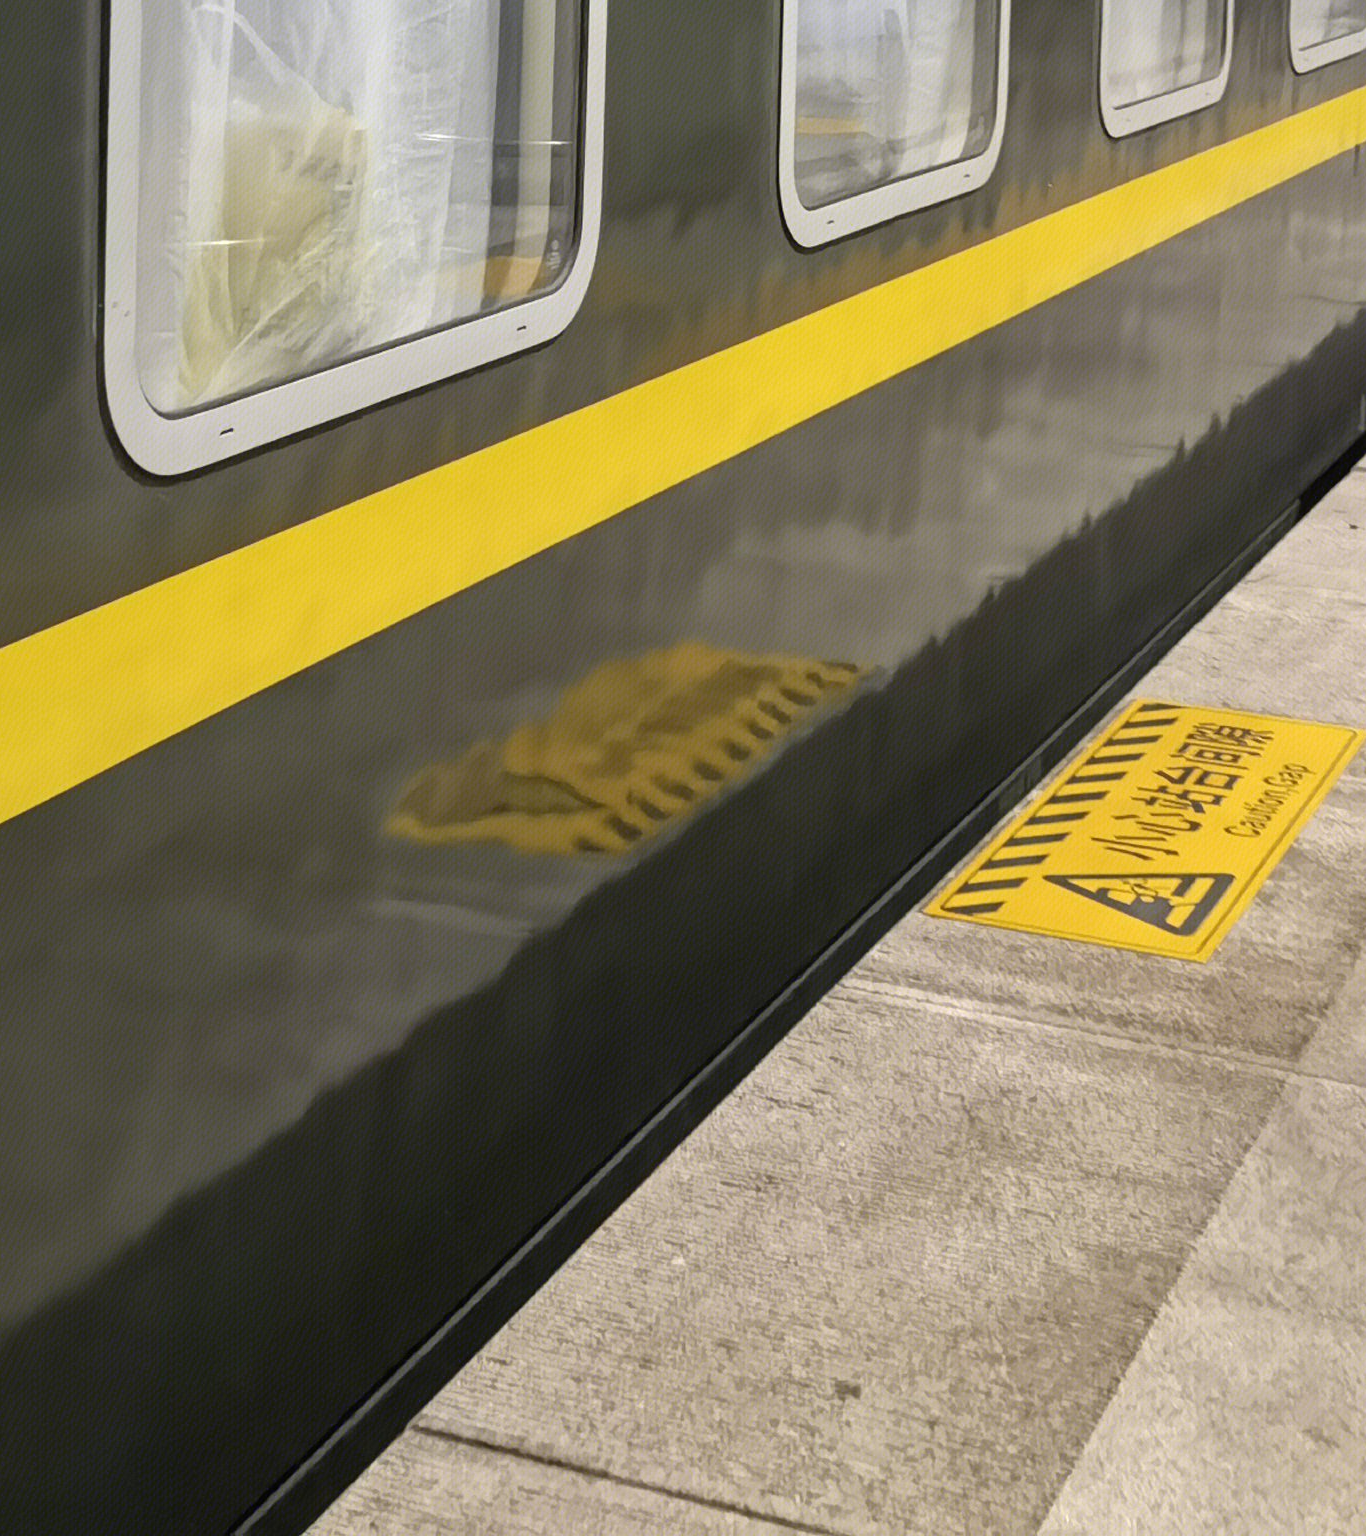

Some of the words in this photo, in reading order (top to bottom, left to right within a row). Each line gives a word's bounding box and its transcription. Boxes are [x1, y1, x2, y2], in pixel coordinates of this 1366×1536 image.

[1090, 722, 1275, 861] 小心站台间隙
